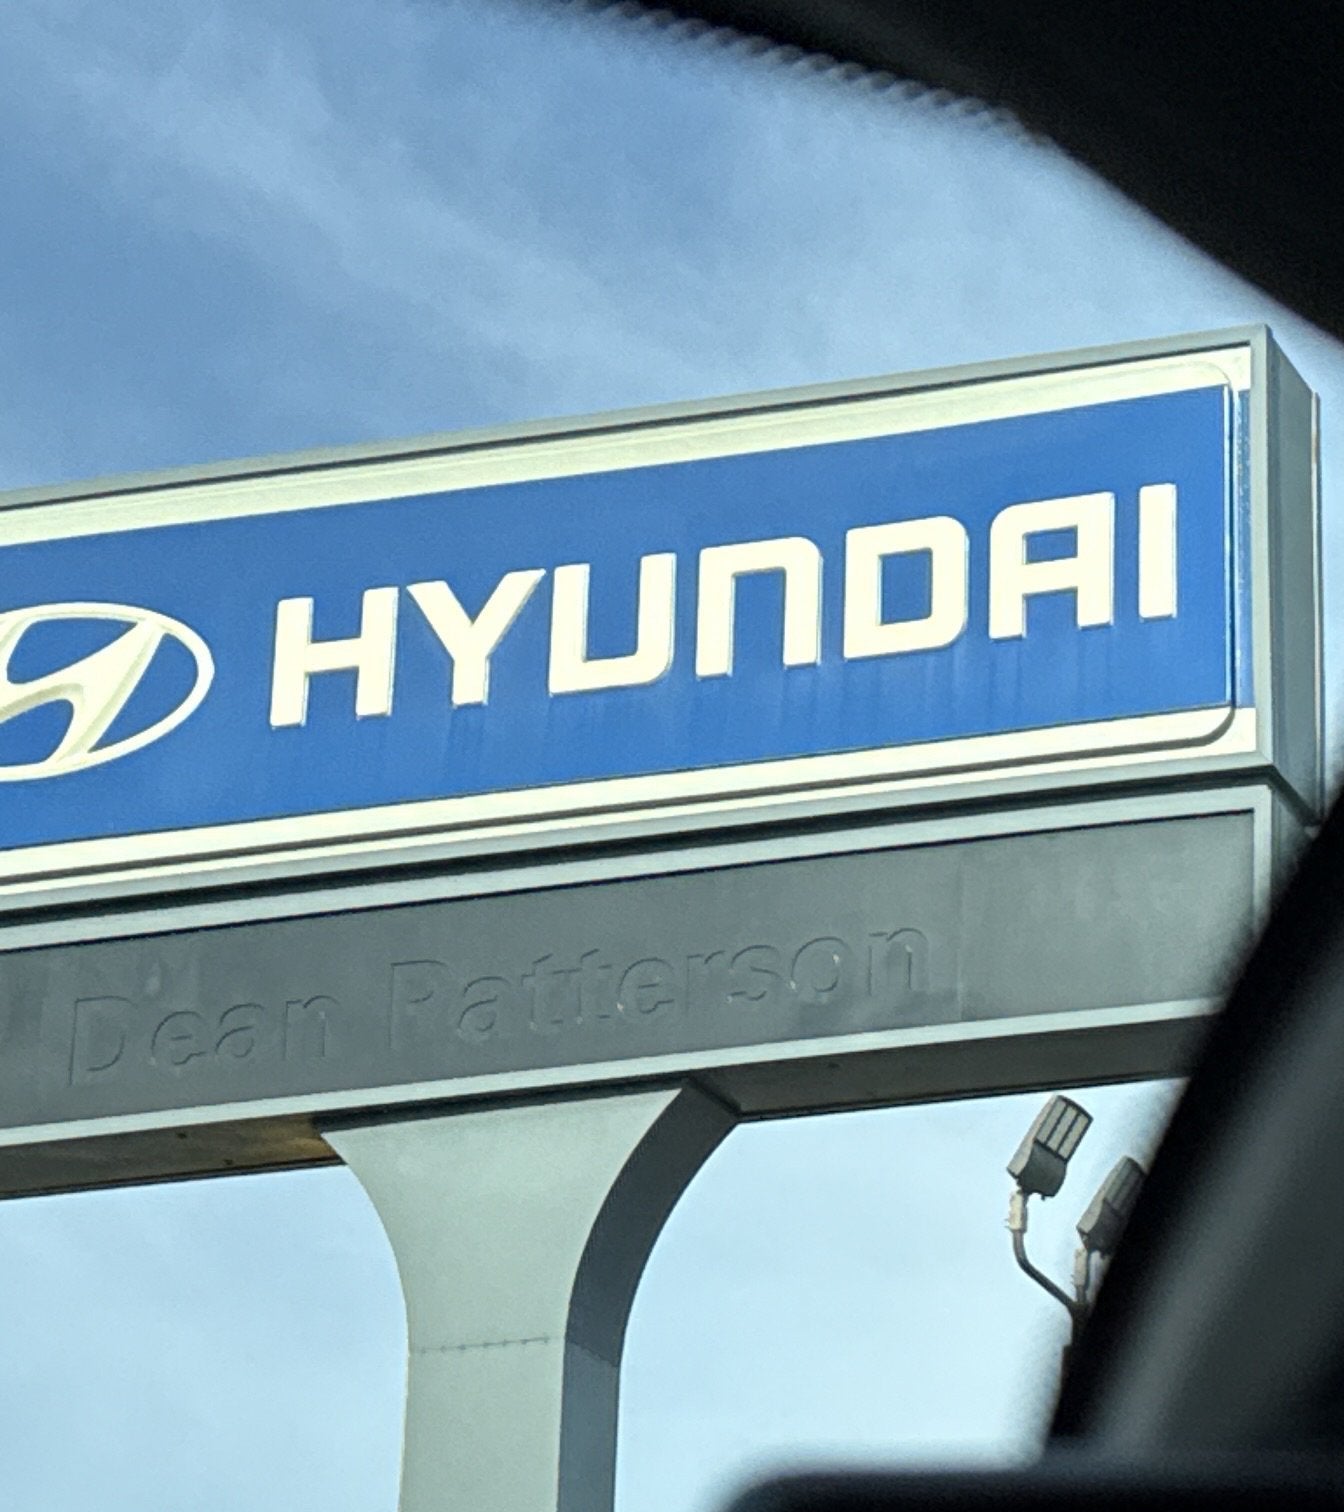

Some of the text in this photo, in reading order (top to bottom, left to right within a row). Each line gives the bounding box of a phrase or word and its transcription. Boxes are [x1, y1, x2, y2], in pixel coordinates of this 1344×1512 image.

[269, 481, 1179, 729] HYUNDAI
[66, 926, 933, 1086] Dean Patterson
